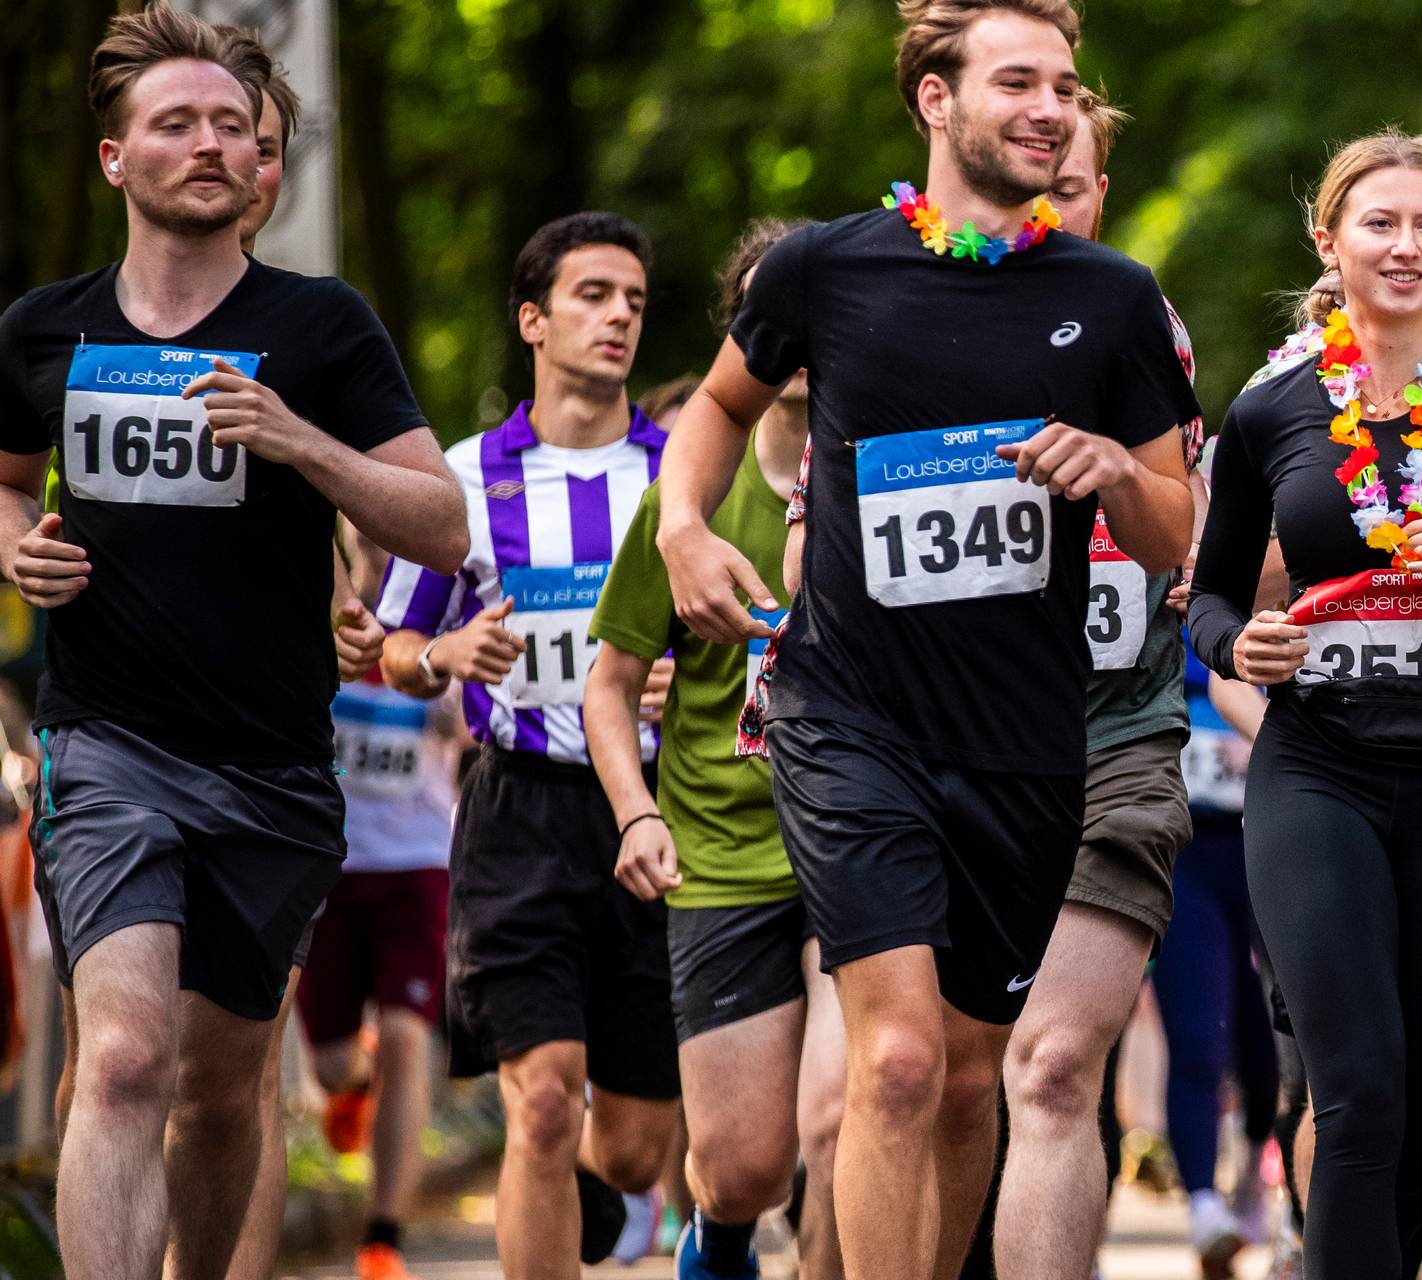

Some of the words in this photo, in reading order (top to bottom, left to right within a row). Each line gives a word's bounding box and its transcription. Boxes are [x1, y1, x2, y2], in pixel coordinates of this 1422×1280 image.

[160, 350, 195, 362] SPORT
[943, 430, 978, 446] SPORT
[74, 413, 239, 483] 1650
[873, 500, 1045, 578] 1349
[1371, 574, 1407, 586] SPORT
